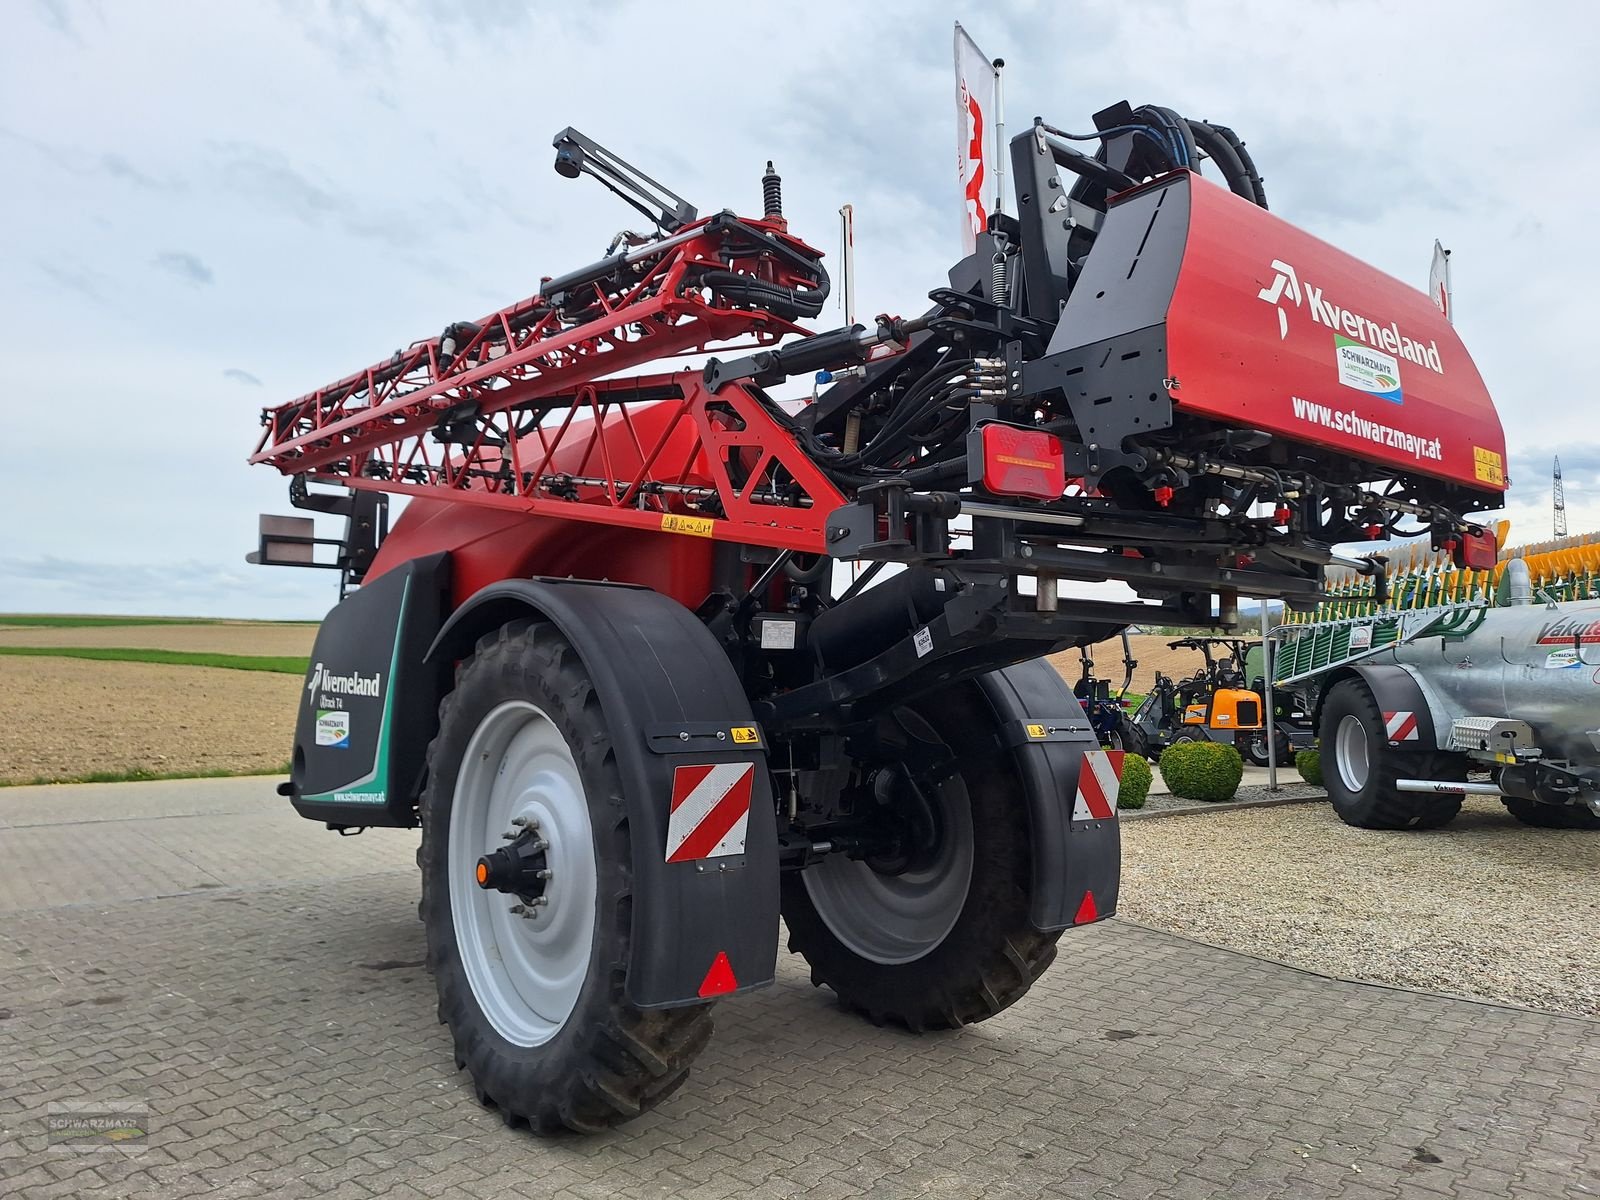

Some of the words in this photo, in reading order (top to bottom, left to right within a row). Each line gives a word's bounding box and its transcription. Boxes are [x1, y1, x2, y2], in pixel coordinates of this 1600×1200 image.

[1303, 281, 1445, 374] Kverneland
[1341, 348, 1392, 375] SCHWARZMAYR
[1291, 396, 1443, 461] www.schwarzmayr.at
[321, 669, 381, 697] Kverneland
[1433, 783, 1465, 793] Vakutec
